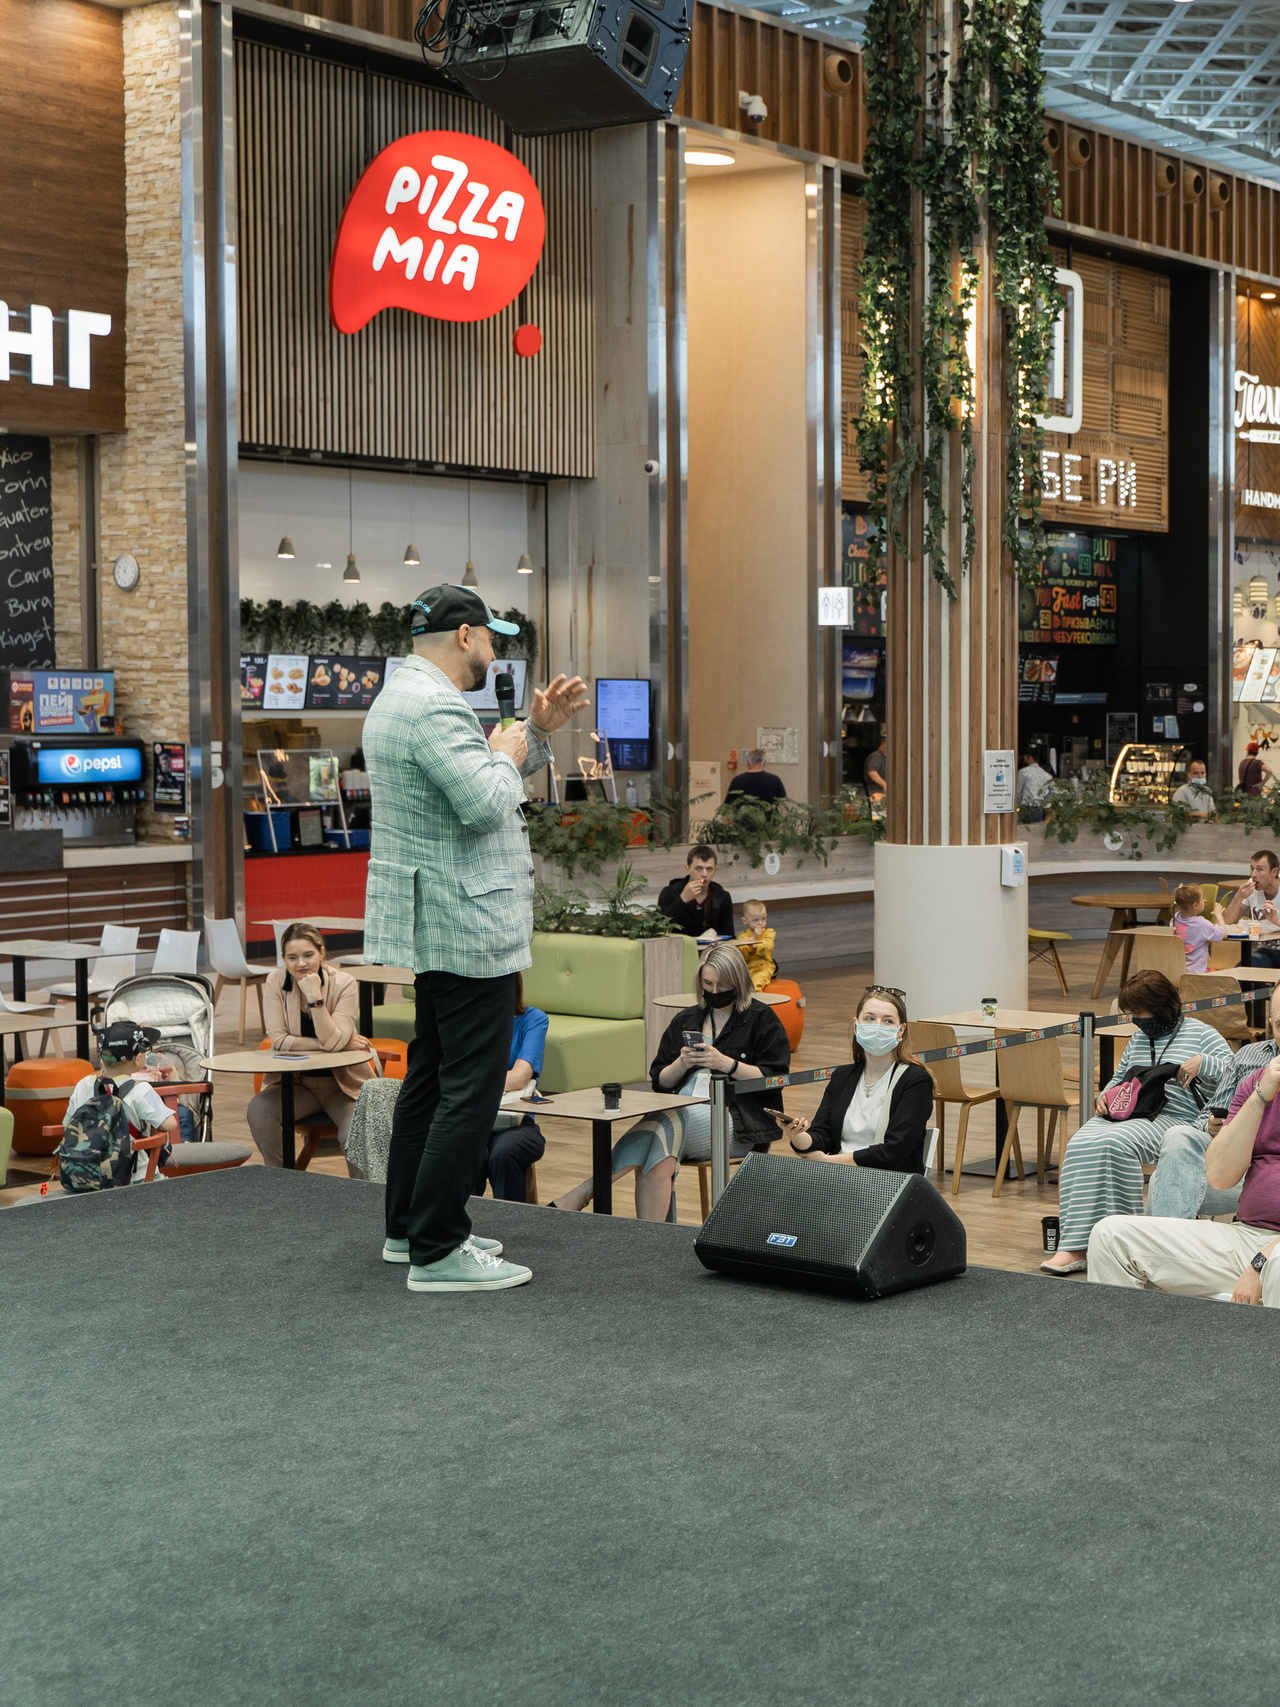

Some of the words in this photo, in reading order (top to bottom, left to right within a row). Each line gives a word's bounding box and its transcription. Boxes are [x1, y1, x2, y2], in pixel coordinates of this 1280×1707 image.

[385, 154, 525, 242] PIZZA
[372, 226, 480, 292] MIA
[1052, 586, 1081, 612] Fast
[83, 755, 122, 773] pepsi
[770, 1234, 795, 1244] FBT
